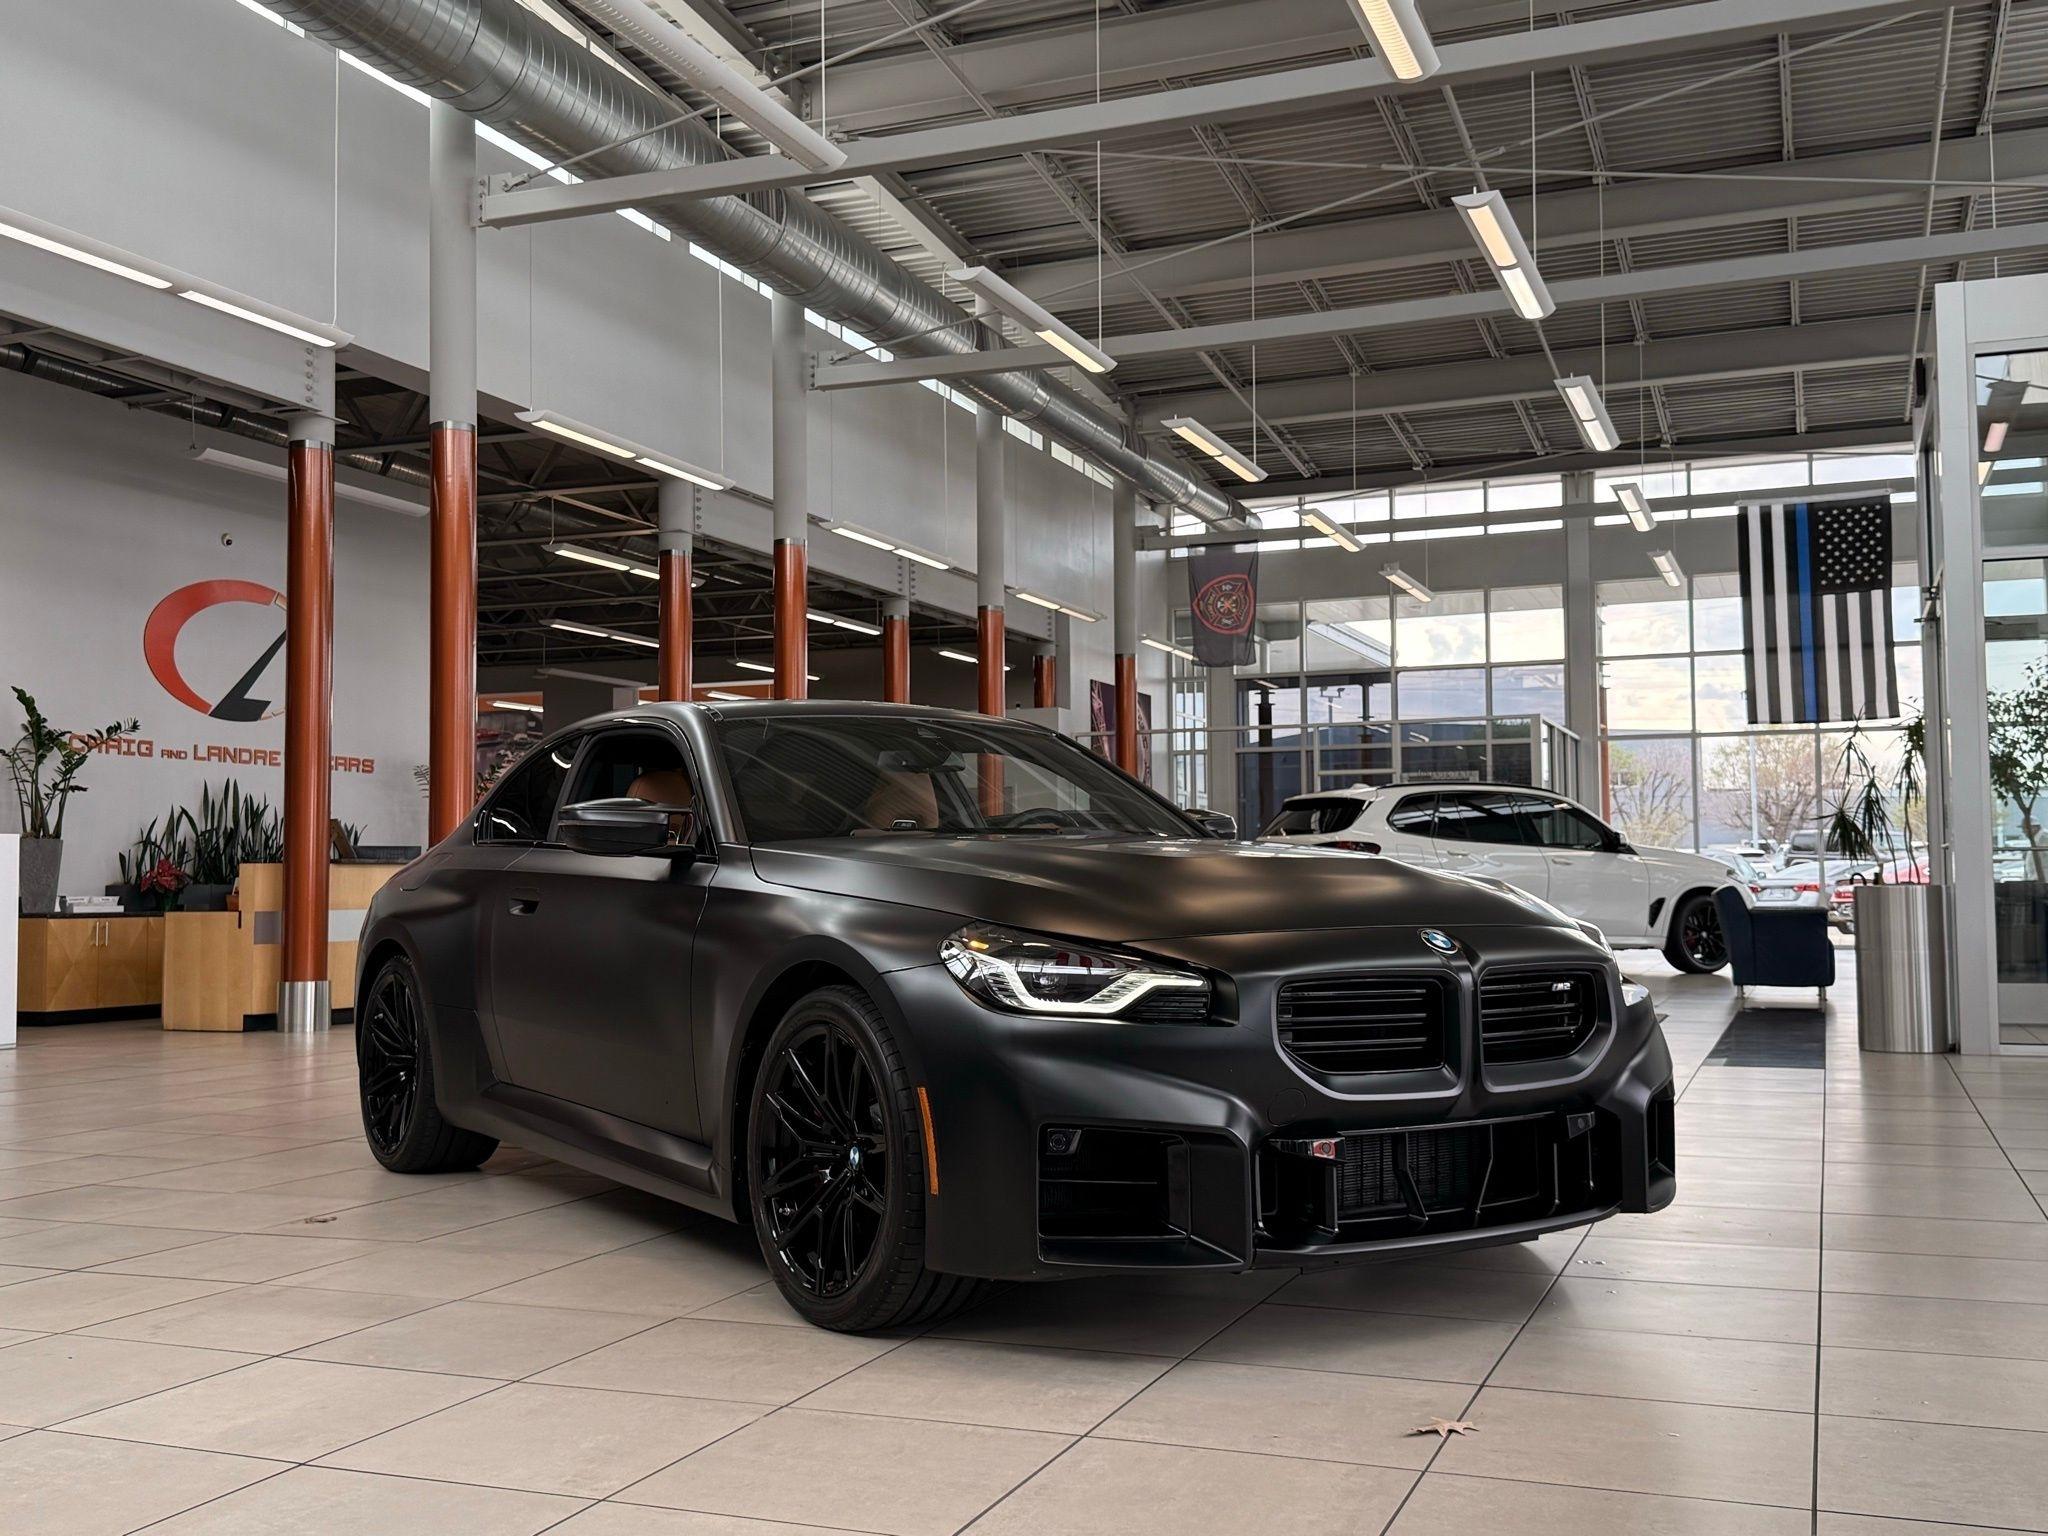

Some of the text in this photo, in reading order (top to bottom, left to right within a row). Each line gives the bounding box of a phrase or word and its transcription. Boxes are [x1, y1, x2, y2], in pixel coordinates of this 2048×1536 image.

[160, 749, 188, 760] AND
[193, 744, 282, 767] LANDRE
[330, 756, 375, 774] ARS
